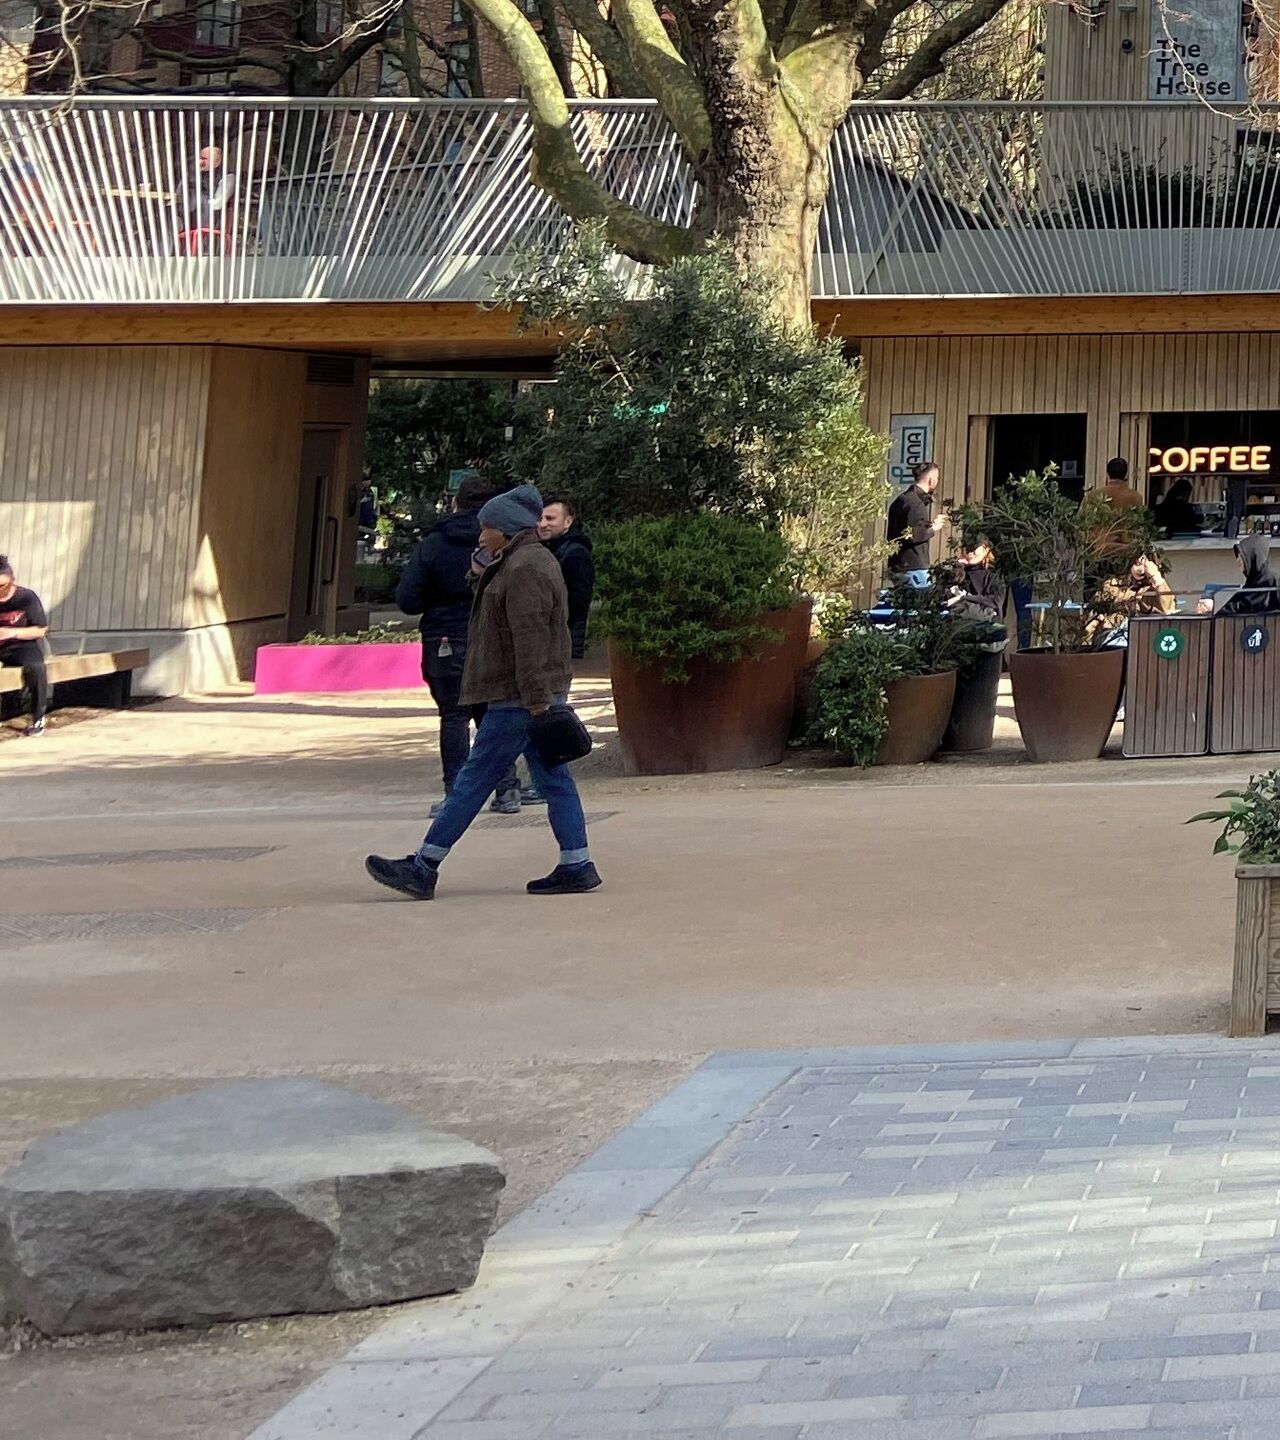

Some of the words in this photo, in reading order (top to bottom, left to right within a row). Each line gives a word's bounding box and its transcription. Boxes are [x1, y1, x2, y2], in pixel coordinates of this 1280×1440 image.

[1157, 38, 1201, 58] The
[1156, 58, 1209, 76] Tree
[1149, 445, 1271, 473] COFFEE
